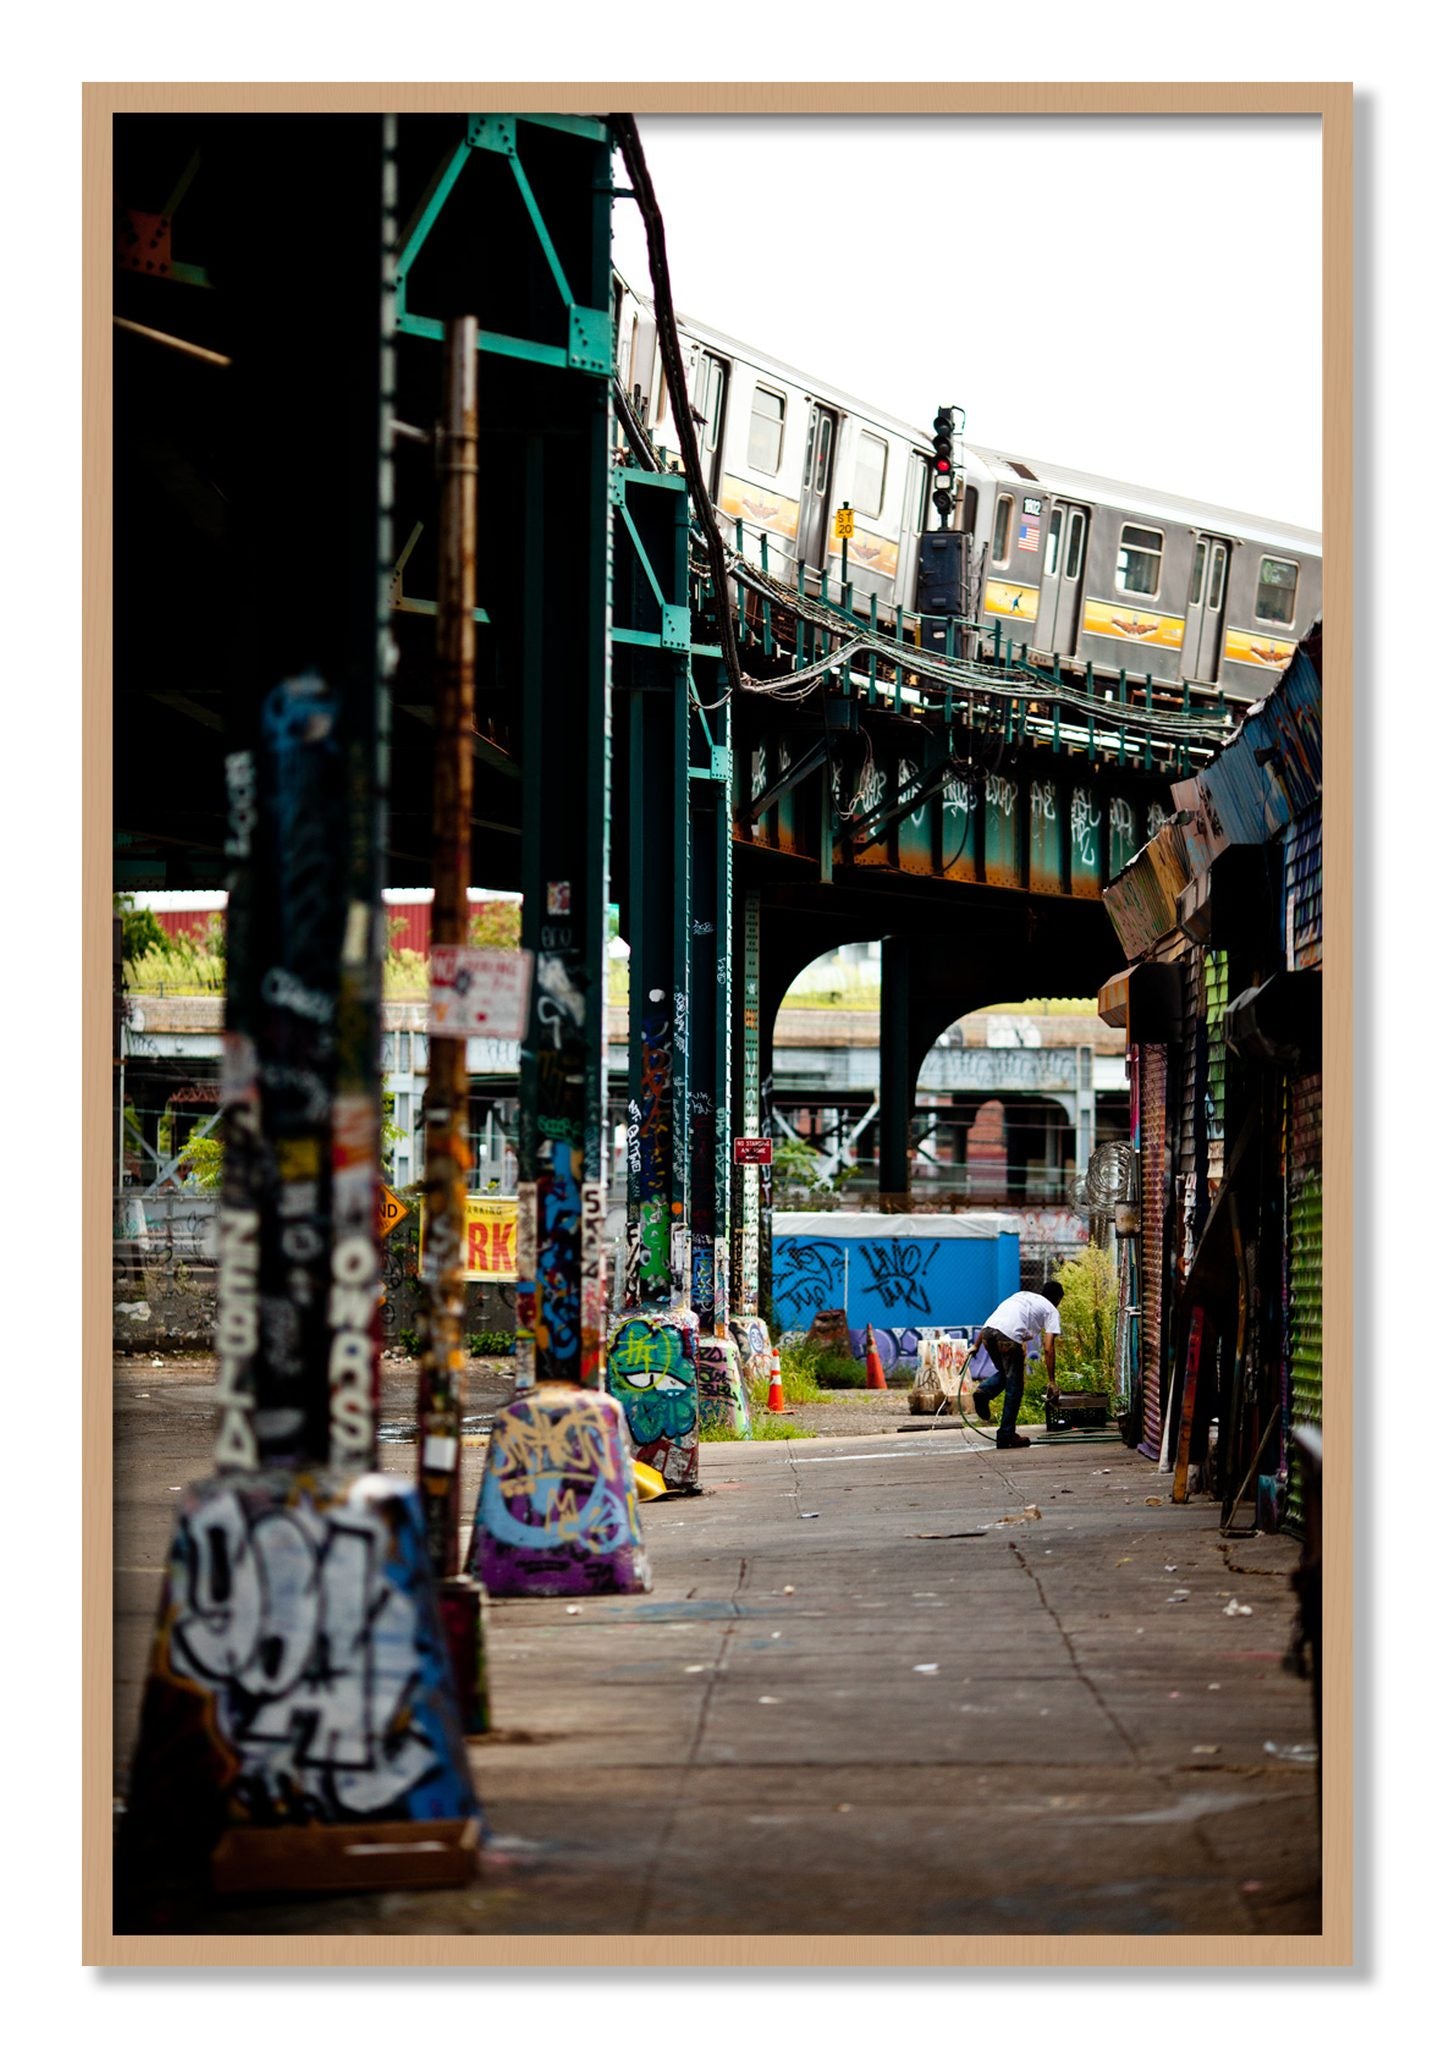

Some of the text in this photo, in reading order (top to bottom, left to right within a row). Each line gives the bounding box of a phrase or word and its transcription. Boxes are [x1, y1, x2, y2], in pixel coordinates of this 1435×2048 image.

[838, 511, 852, 523] ST
[838, 524, 852, 534] 20
[468, 1222, 515, 1271] RK
